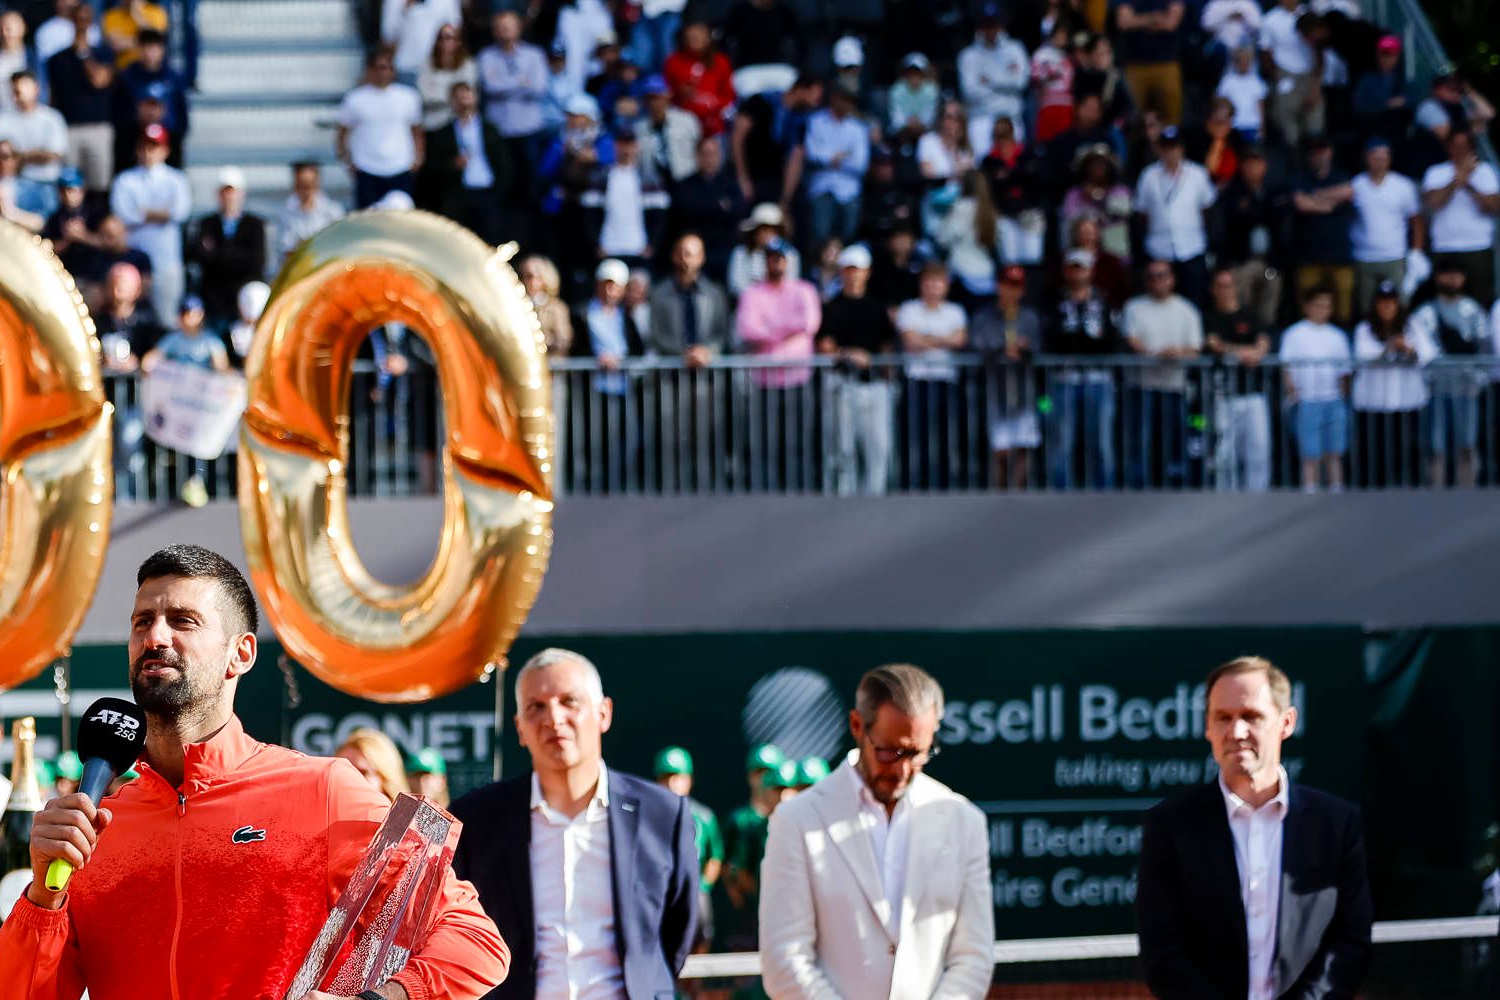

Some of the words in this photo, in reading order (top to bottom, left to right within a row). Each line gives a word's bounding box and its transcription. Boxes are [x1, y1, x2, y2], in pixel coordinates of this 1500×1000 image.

[88, 708, 140, 730] ATP
[938, 683, 1063, 745] ssell
[114, 727, 136, 741] 250
[1054, 753, 1146, 791] taking
[1148, 761, 1201, 789] you
[1021, 817, 1143, 858] Bedfor
